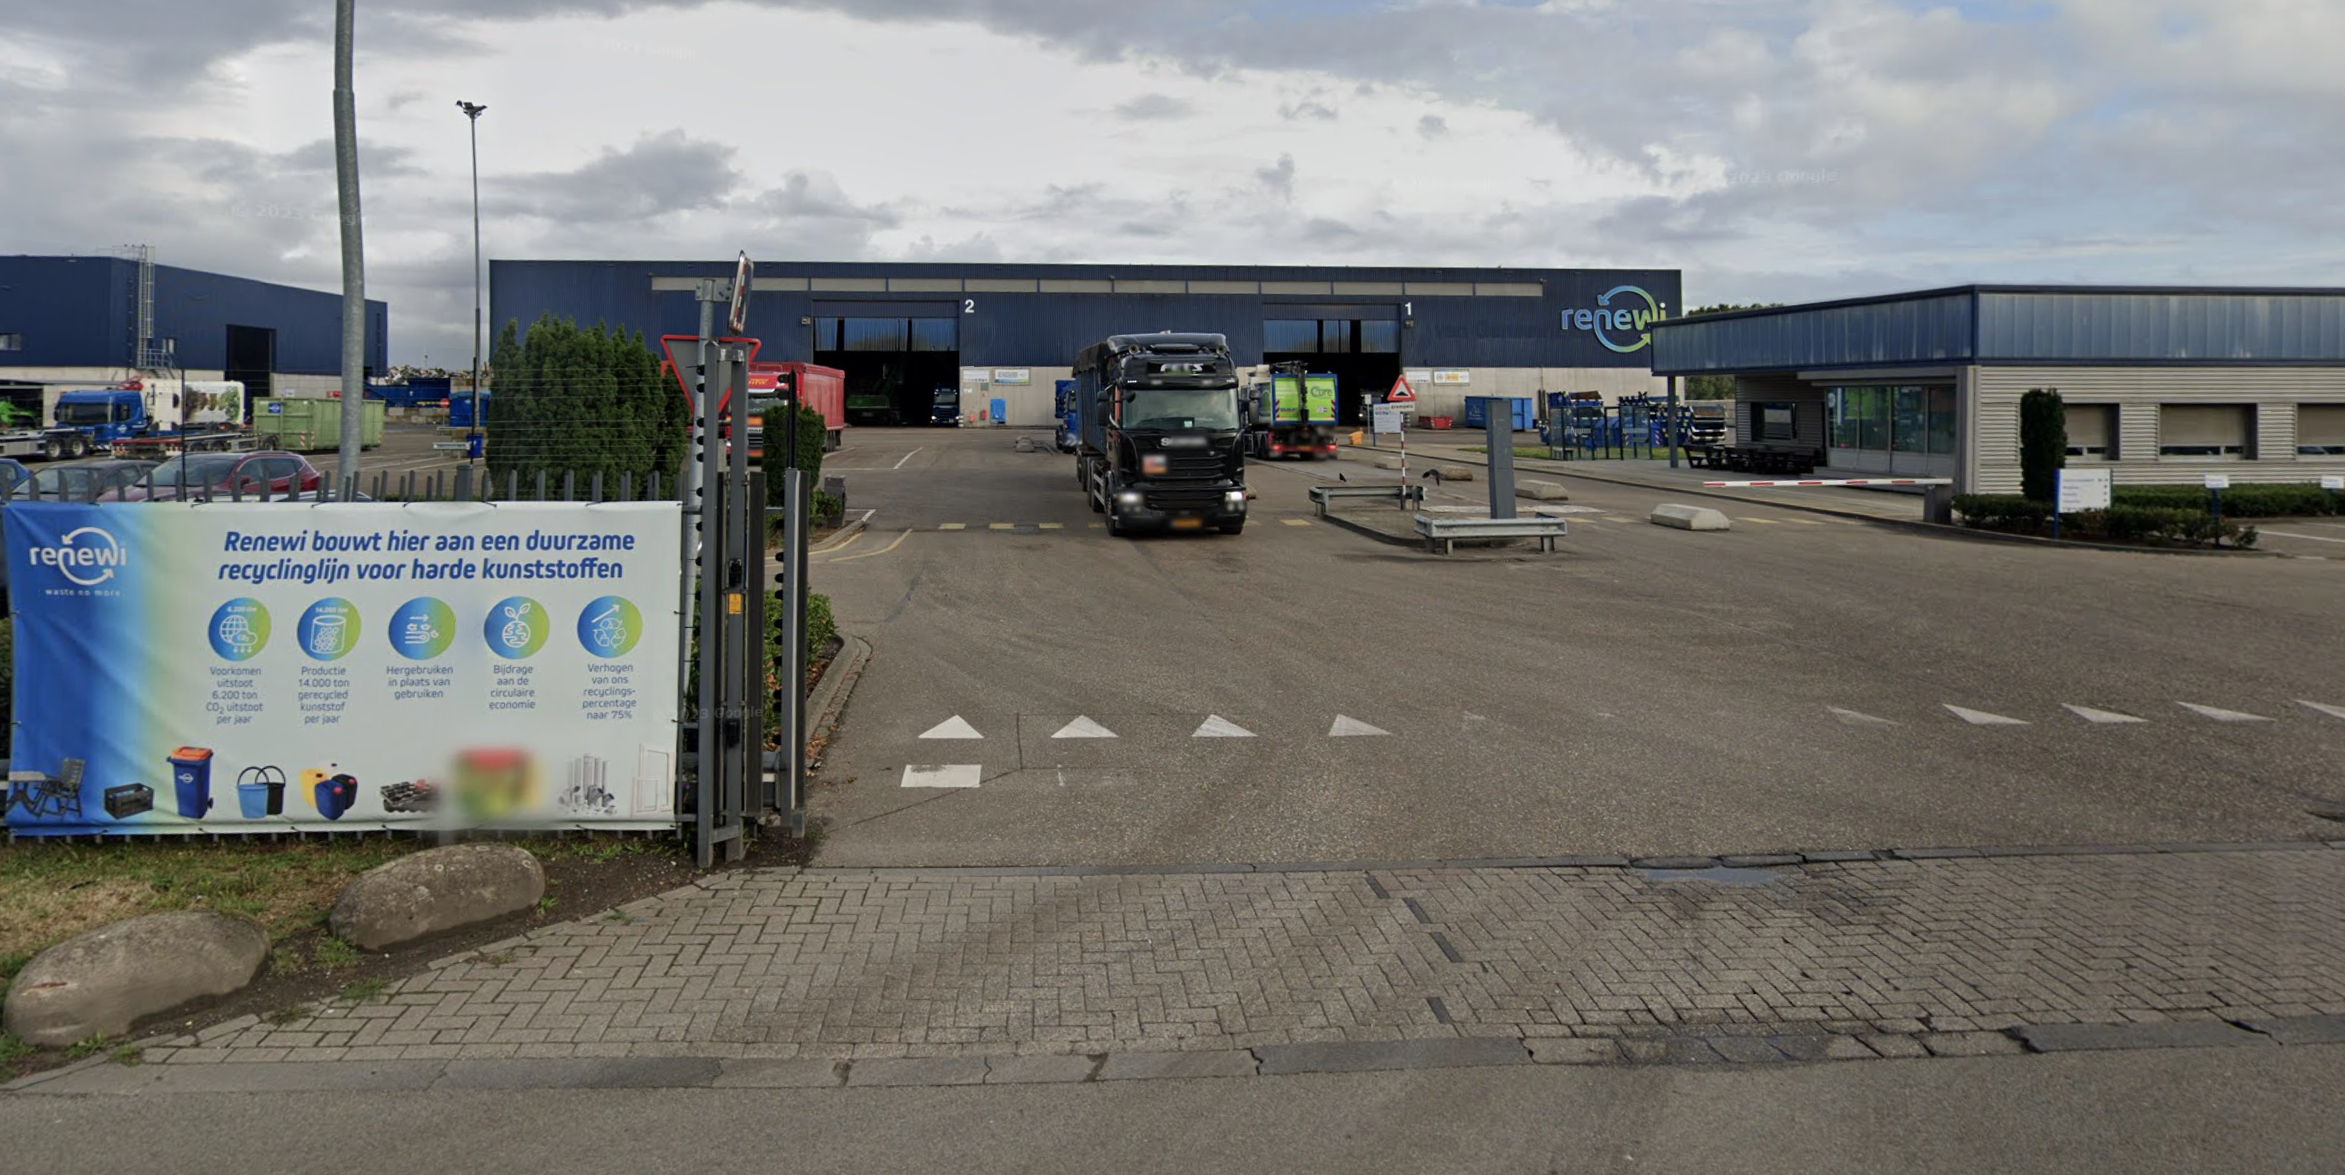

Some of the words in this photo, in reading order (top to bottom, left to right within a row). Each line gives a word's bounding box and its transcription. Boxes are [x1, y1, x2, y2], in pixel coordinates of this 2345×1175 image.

[964, 299, 975, 313] 2
[1405, 302, 1412, 315] 1
[1561, 302, 1666, 331] renewi
[224, 530, 308, 552] Renewi
[312, 530, 382, 552] bouwt
[387, 530, 430, 551] hier
[435, 535, 475, 551] aan
[481, 534, 520, 551] een
[525, 530, 635, 551] duurzame
[29, 542, 128, 566] renewi
[218, 558, 350, 584] recyclinglijn
[357, 563, 406, 580] voor
[411, 558, 476, 580] harde
[482, 557, 623, 579] kunststoffen
[210, 666, 262, 676] Voorkomen
[301, 666, 347, 676] Productie
[386, 665, 454, 676] Hergebruiken
[493, 664, 534, 676] Bijdrage
[587, 663, 634, 674] Verhogen
[217, 679, 253, 688] uitstoot
[299, 678, 331, 688] 14.000
[333, 679, 350, 688] ton
[388, 677, 398, 687] in
[400, 677, 431, 687] plaats
[432, 678, 451, 687] van
[496, 677, 511, 686] aan
[516, 676, 530, 686] de
[591, 676, 609, 685] van
[611, 676, 629, 684] ons
[212, 690, 240, 700] 6.200
[242, 691, 258, 700] ton
[298, 690, 349, 701] gerecycled
[394, 689, 444, 700] gebruiken
[490, 688, 535, 698] circulaire
[583, 686, 636, 697] recyclings-
[226, 702, 264, 712] uitstoot
[300, 701, 346, 712] kunststof
[489, 700, 535, 709] economie
[582, 698, 637, 709] percentage
[216, 716, 233, 725] per
[234, 715, 252, 725] jaar
[304, 716, 320, 725] per
[322, 715, 341, 725] jaar
[586, 711, 609, 720] naar
[611, 710, 632, 719] 75%
